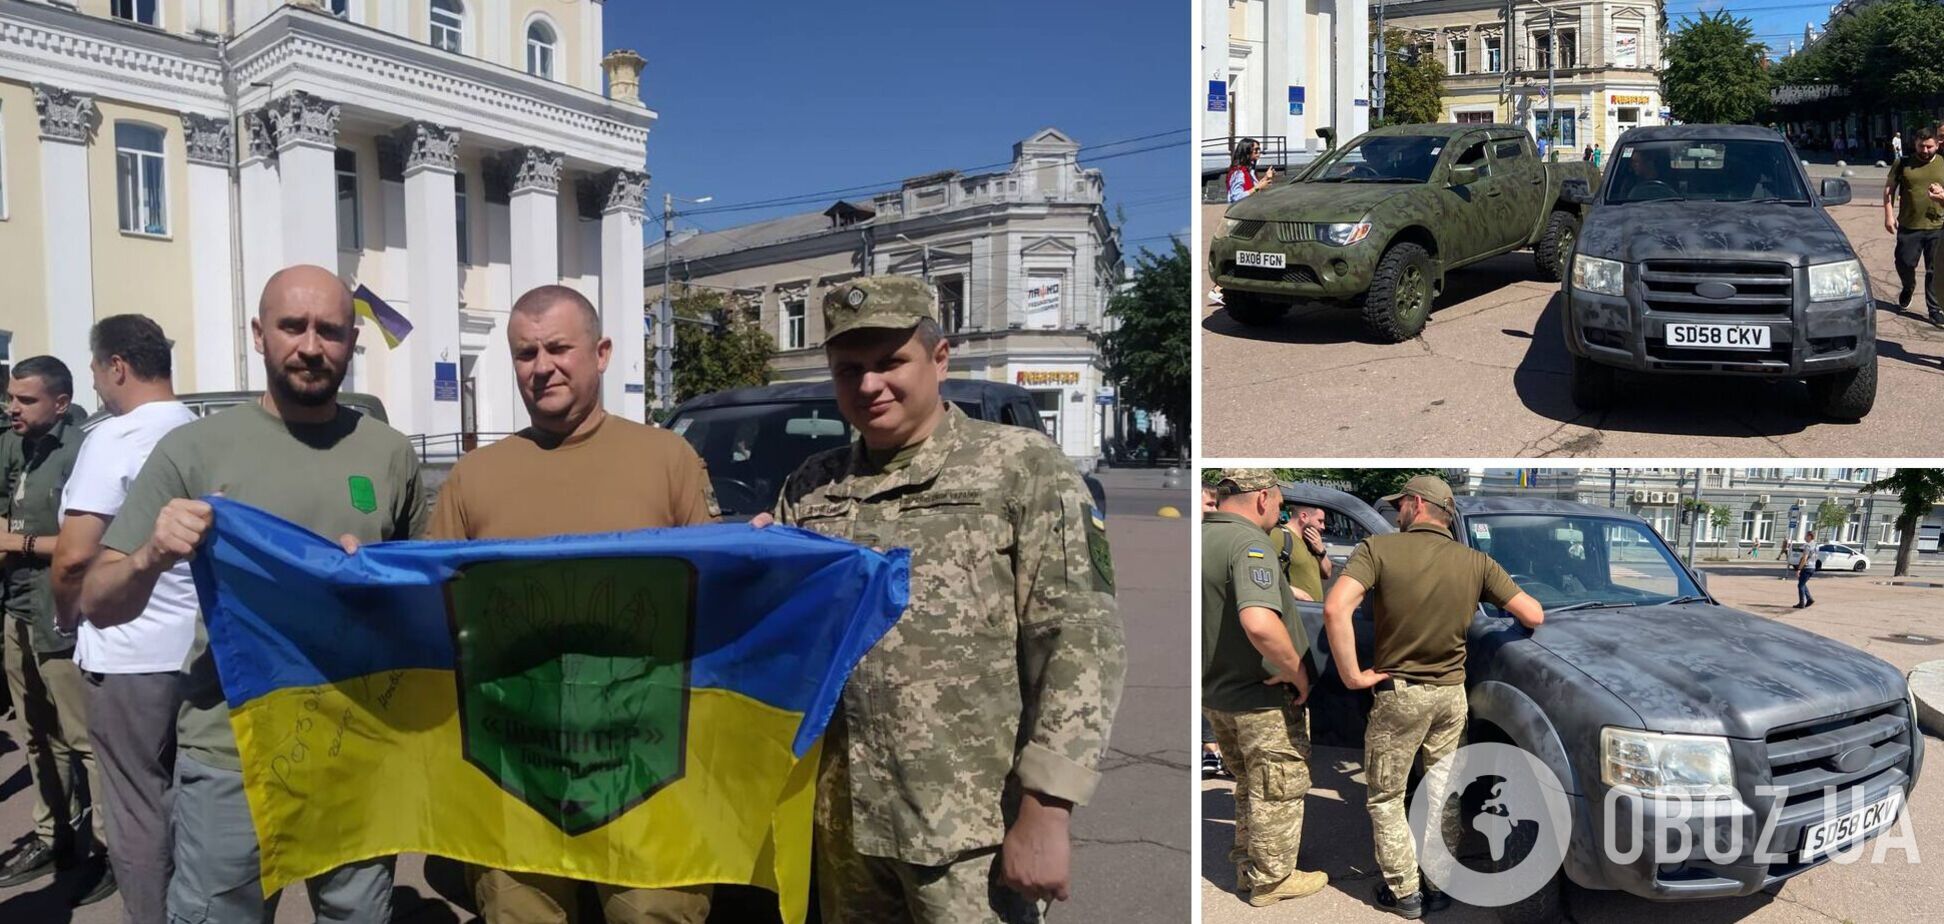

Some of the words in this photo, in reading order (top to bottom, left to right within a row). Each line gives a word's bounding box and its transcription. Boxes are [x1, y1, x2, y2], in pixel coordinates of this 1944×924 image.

[1240, 252, 1261, 265] BX08
[1263, 254, 1282, 267] FGN
[1674, 326, 1721, 343] SD58
[1727, 328, 1762, 345] CKV
[1813, 815, 1860, 851] SD58
[1863, 797, 1896, 830] CKV
